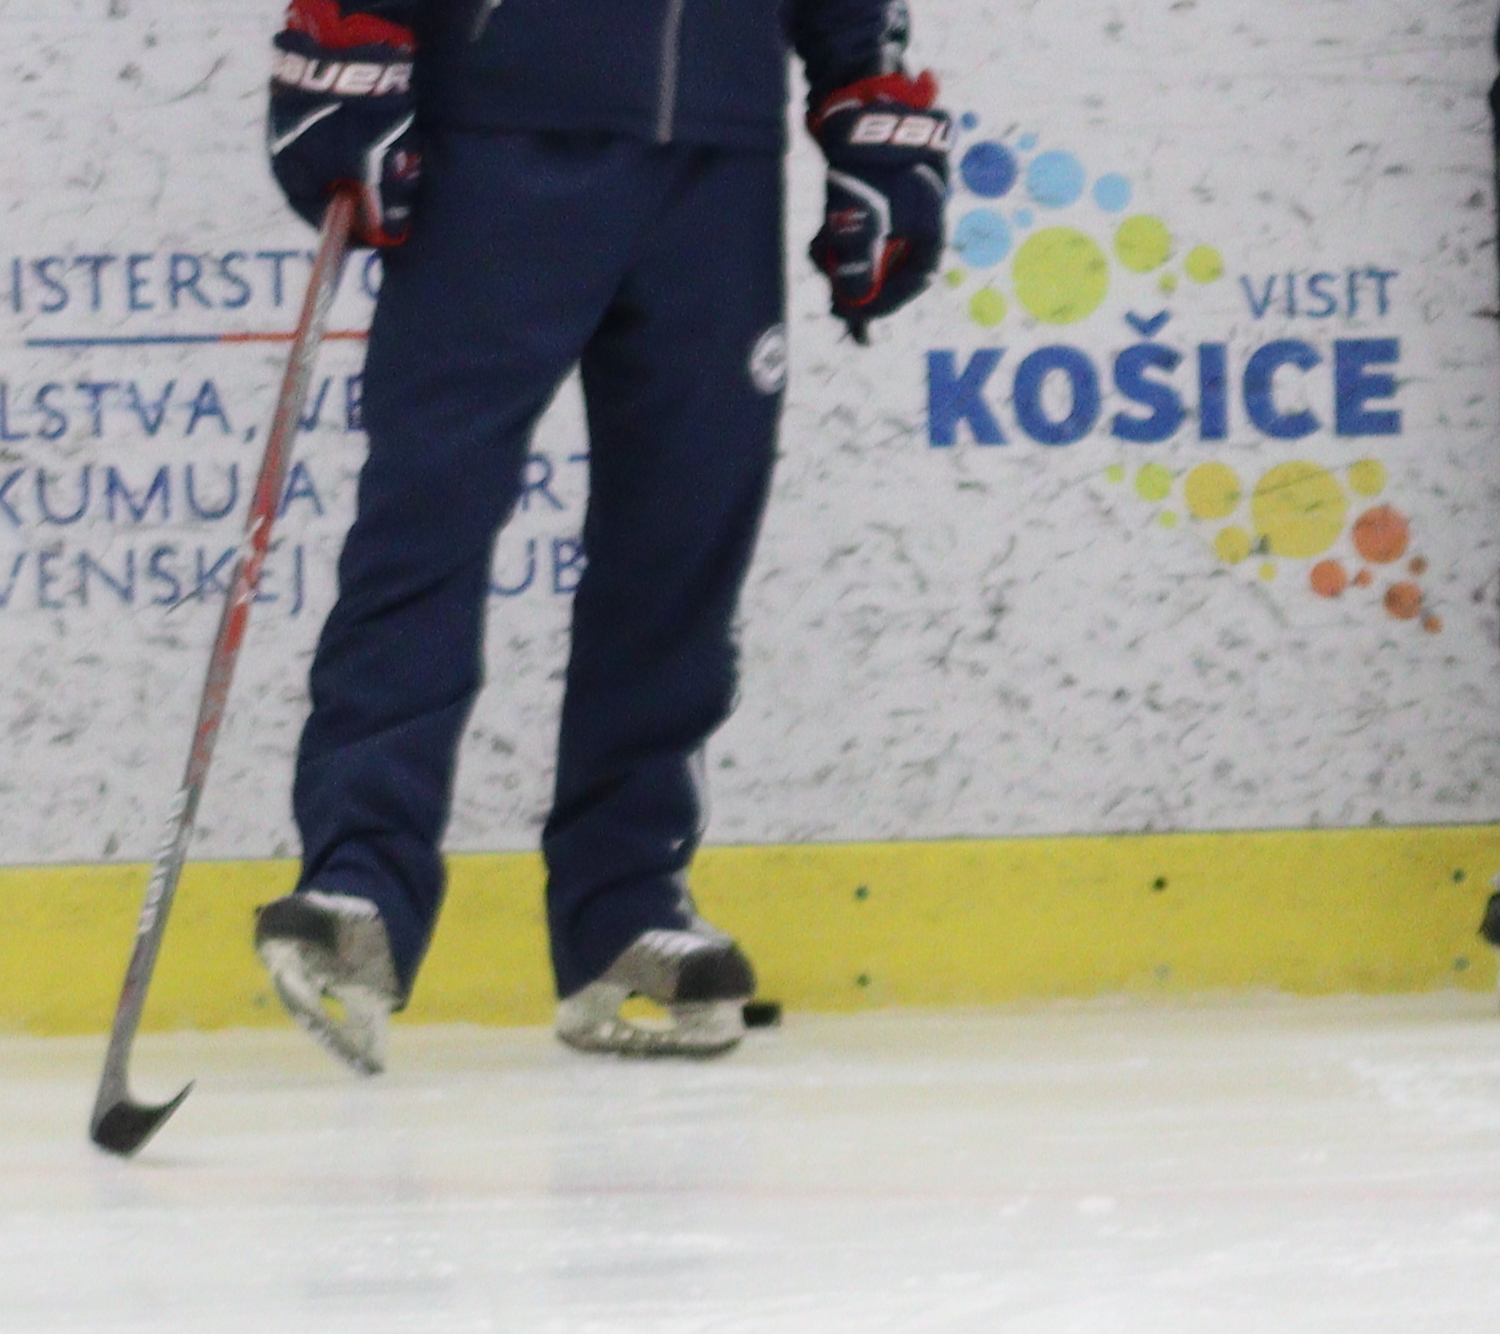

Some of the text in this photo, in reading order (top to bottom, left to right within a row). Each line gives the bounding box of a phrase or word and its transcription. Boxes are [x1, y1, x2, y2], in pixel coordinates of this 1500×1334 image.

[272, 52, 414, 95] AUER
[851, 114, 950, 152] BAU
[1240, 266, 1401, 321] VISIT
[926, 309, 1402, 448] KOŠICE
